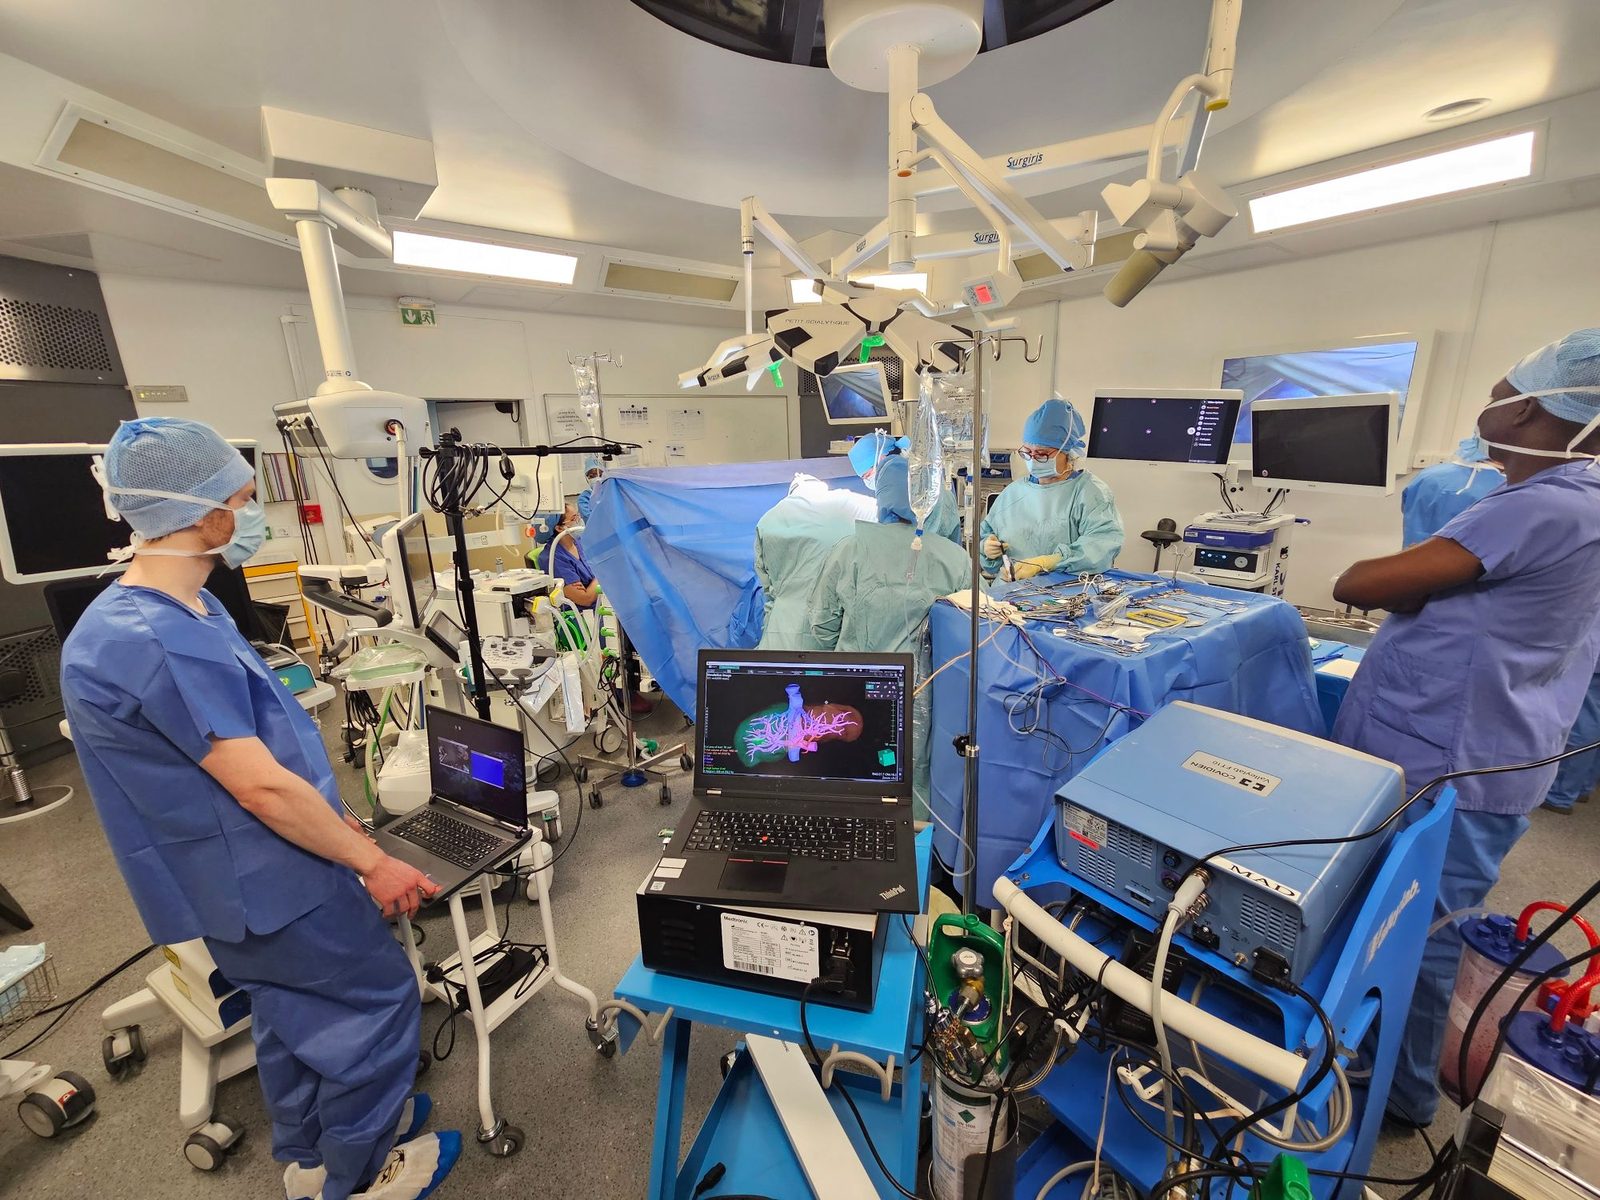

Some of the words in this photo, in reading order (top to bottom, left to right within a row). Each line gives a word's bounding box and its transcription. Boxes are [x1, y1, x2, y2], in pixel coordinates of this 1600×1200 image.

[1006, 152, 1043, 170] Surgiris
[973, 231, 1000, 244] Surgi
[1190, 761, 1237, 781] COVIDIEN
[1211, 760, 1232, 770] FT10
[1233, 767, 1270, 784] Valleylab
[1230, 864, 1296, 898] MAD
[879, 884, 906, 900] ThinkPad
